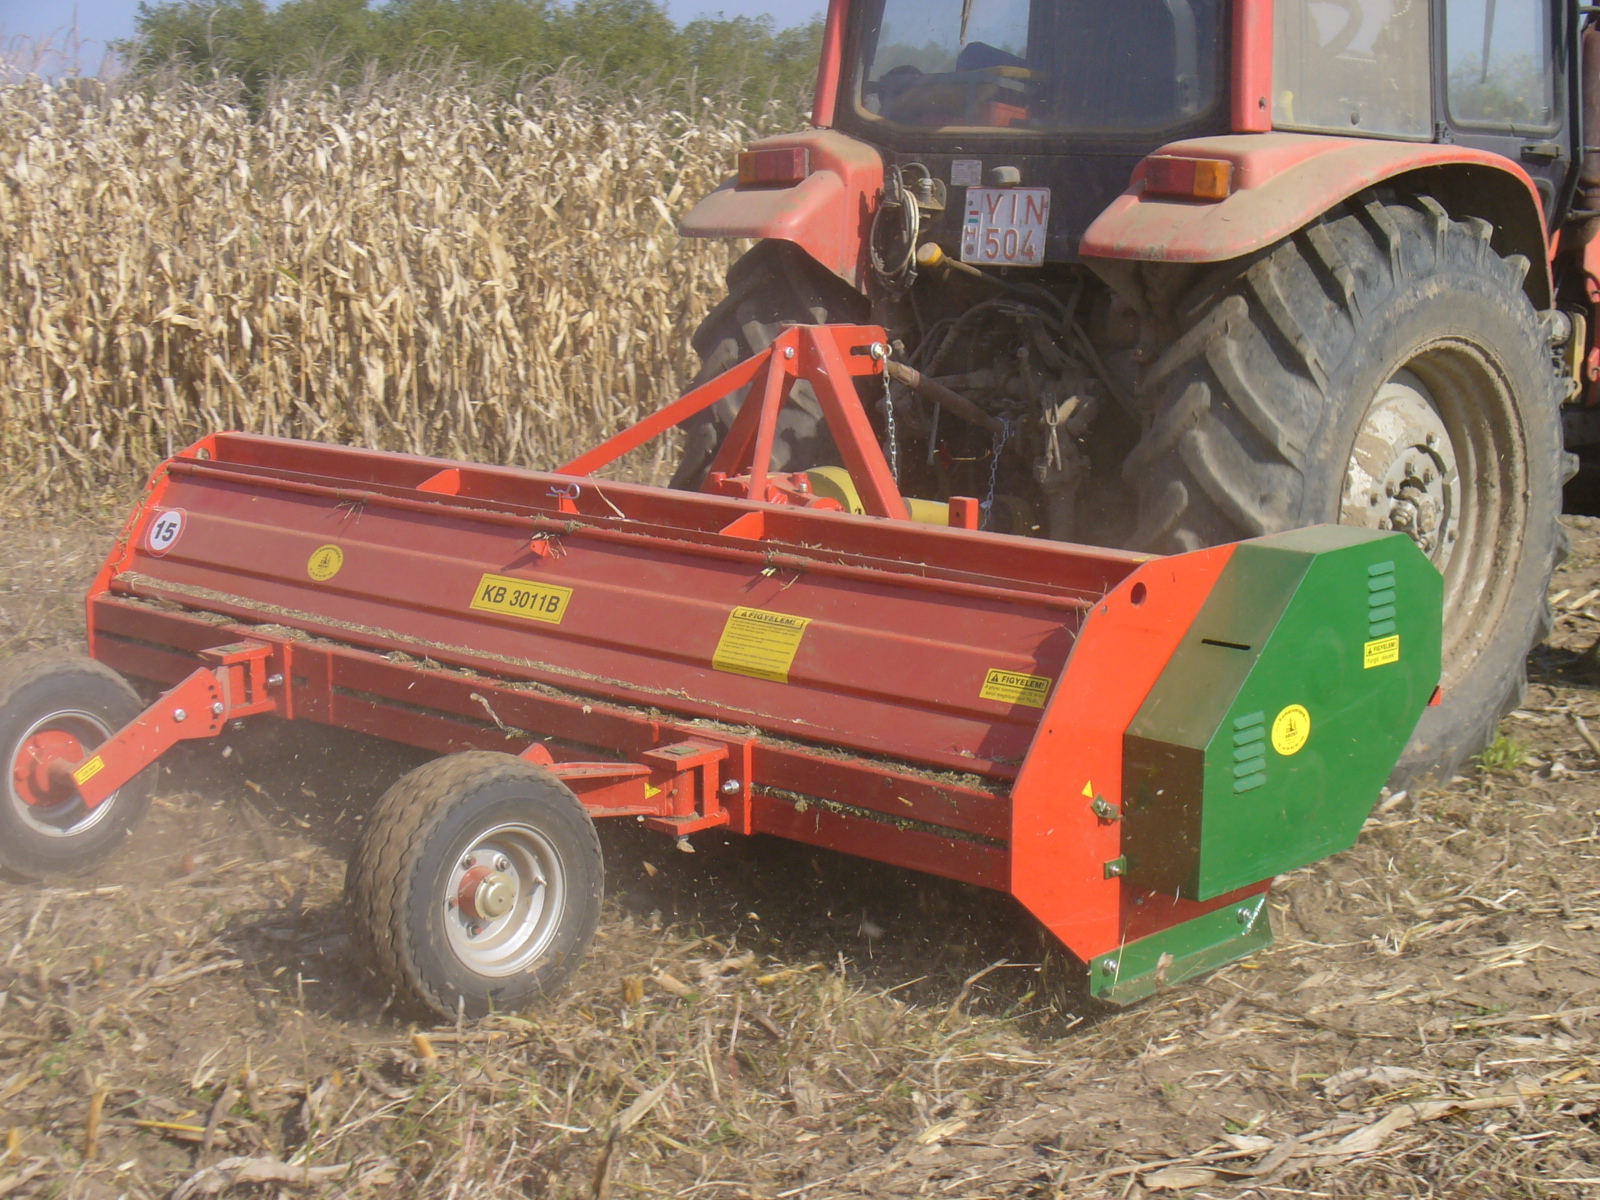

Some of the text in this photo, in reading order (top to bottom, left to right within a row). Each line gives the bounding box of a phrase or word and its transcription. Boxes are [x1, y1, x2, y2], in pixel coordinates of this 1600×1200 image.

[986, 193, 1046, 225] YIN
[985, 227, 1035, 261] 504
[154, 520, 177, 542] 15
[481, 584, 561, 613] KB 3011B
[748, 611, 796, 626] FIGYELEM!
[1001, 675, 1045, 690] FIGYELEM!
